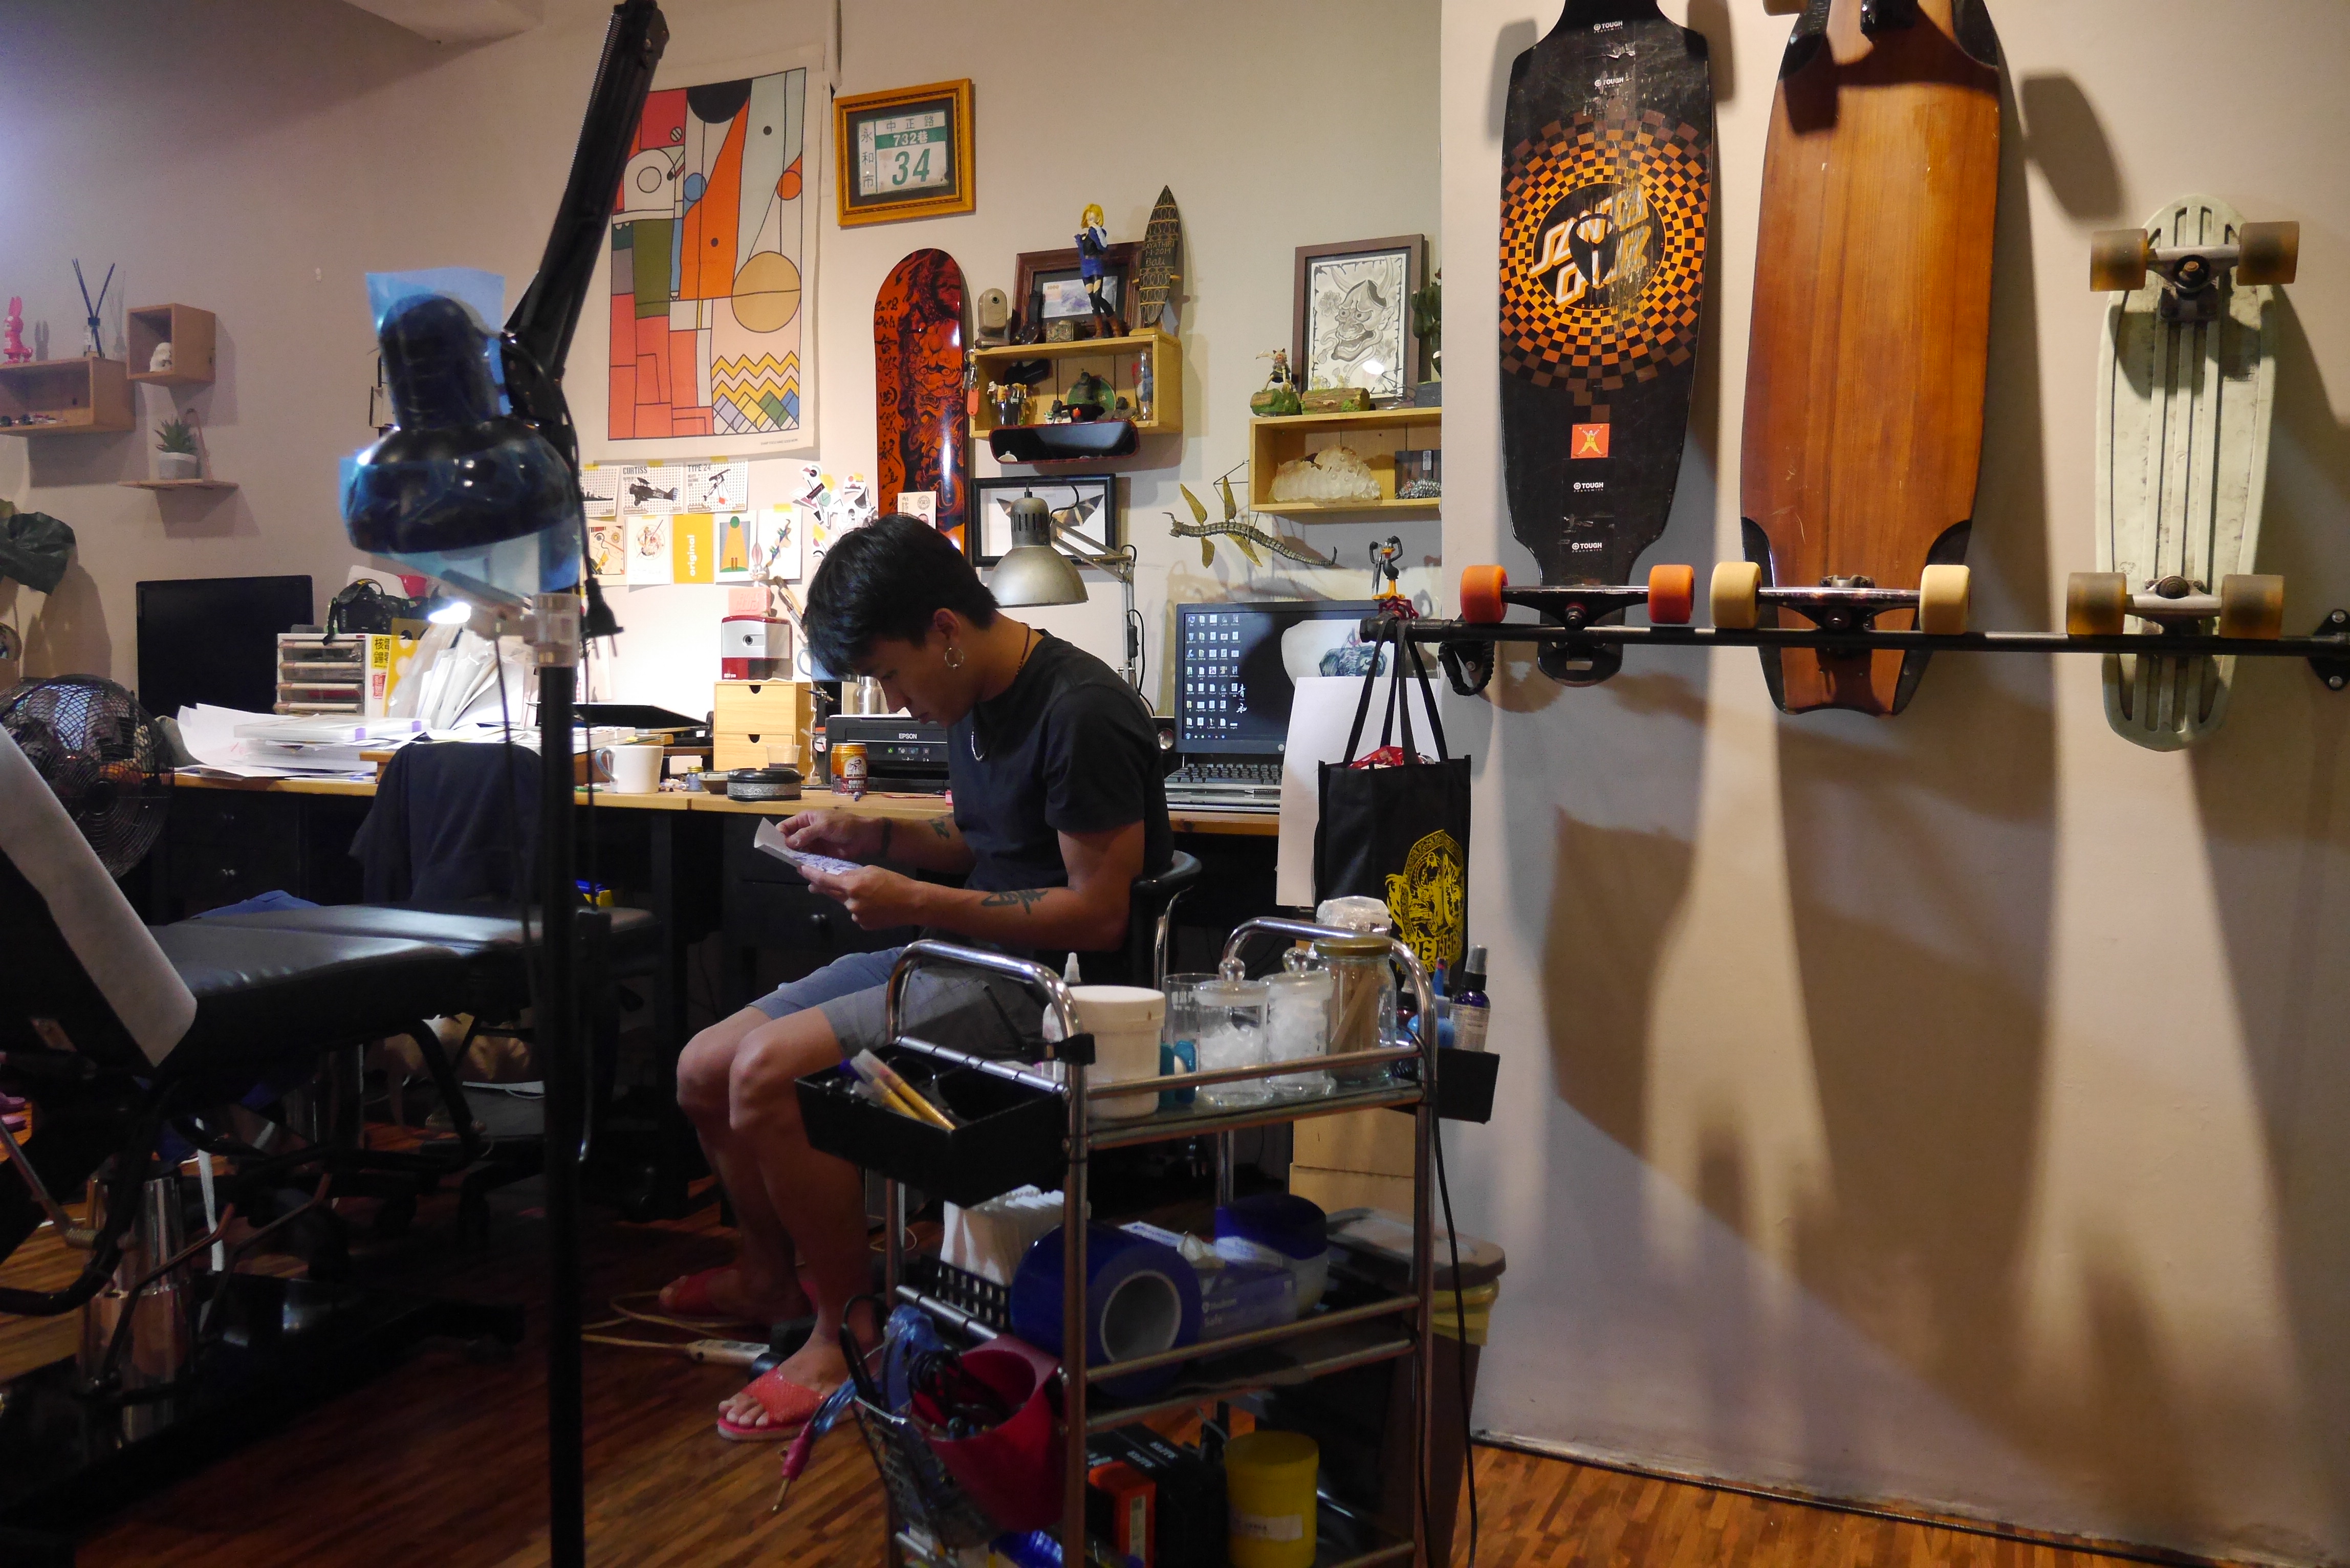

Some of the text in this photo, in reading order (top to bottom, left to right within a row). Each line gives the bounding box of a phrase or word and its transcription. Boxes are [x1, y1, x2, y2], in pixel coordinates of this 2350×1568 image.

[1601, 20, 1623, 29] TOUGH
[1603, 77, 1624, 85] TOUGH
[886, 116, 934, 132] 中正路
[893, 131, 928, 146] 732巷
[861, 129, 875, 188] 永和市
[892, 148, 930, 186] 34
[1146, 257, 1165, 266] Bali
[623, 466, 647, 475] CURTISS
[688, 464, 702, 472] TYPE
[687, 535, 697, 576] original
